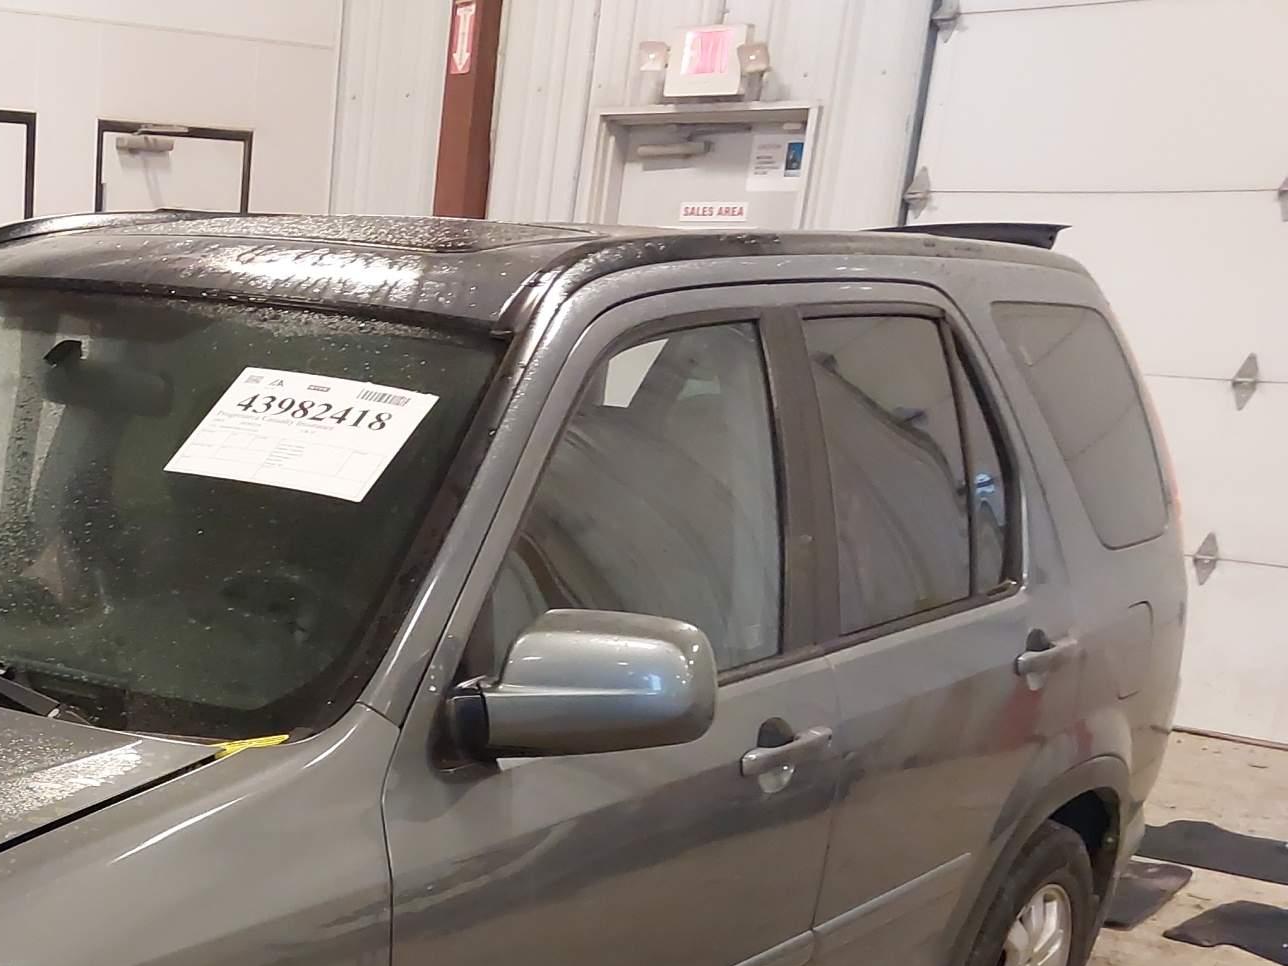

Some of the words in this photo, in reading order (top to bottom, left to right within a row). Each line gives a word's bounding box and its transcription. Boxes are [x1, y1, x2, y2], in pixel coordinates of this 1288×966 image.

[683, 206, 713, 217] SALES
[717, 206, 744, 217] AREA
[236, 393, 393, 431] 43982418
